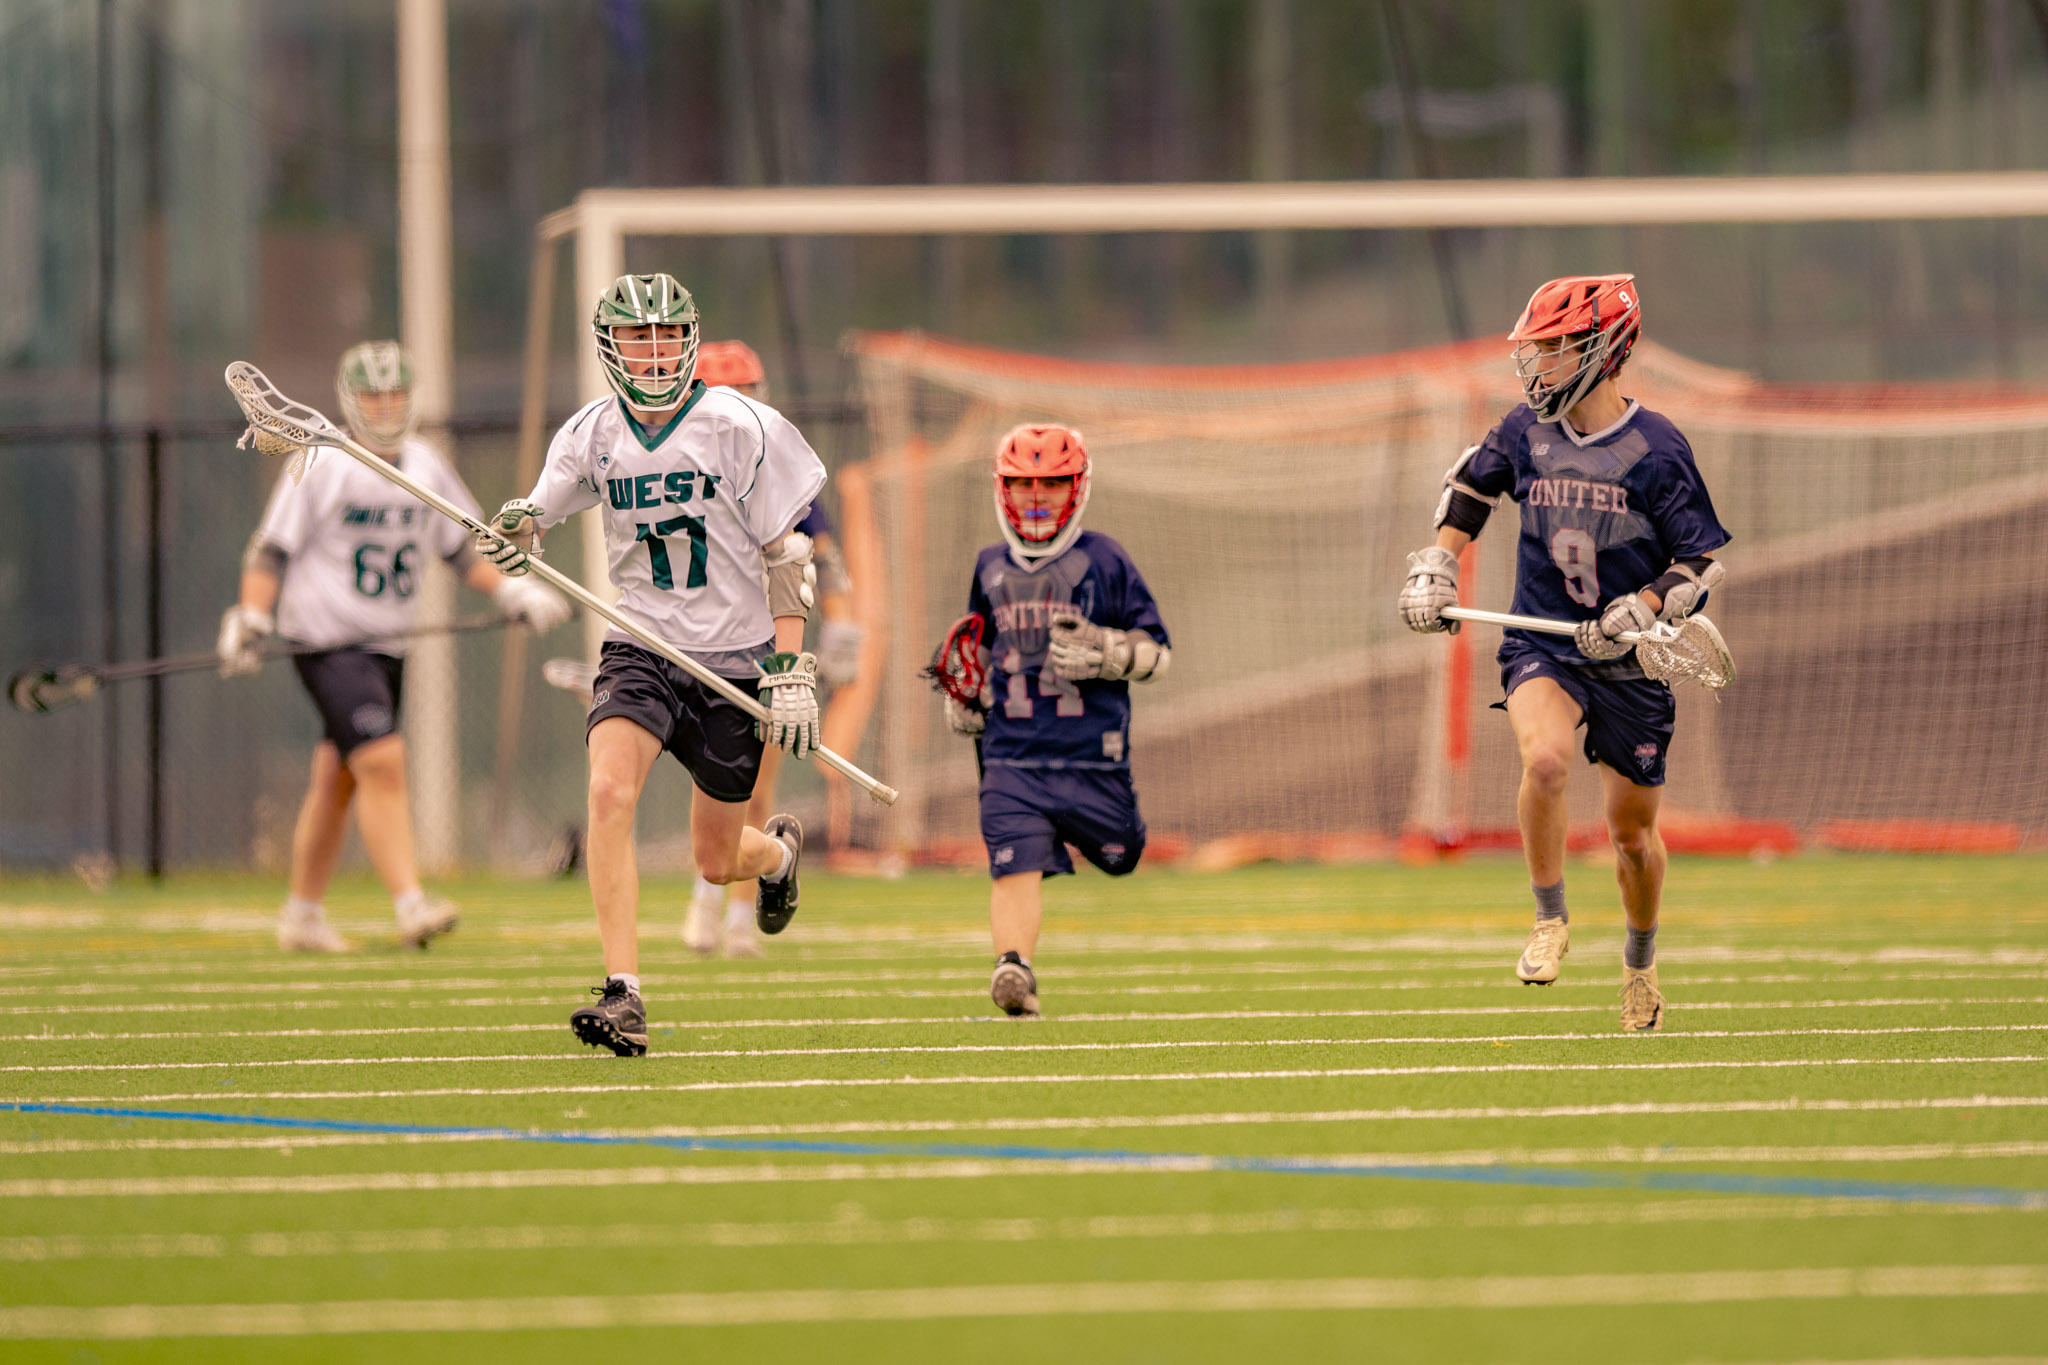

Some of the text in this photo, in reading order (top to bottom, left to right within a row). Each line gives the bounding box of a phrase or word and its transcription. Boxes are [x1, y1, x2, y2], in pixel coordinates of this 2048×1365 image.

[1618, 290, 1633, 309] 9
[607, 469, 722, 511] WEST
[1528, 478, 1628, 514] UNITED
[354, 543, 417, 598] 66
[635, 514, 709, 591] 17
[1552, 527, 1600, 608] 9
